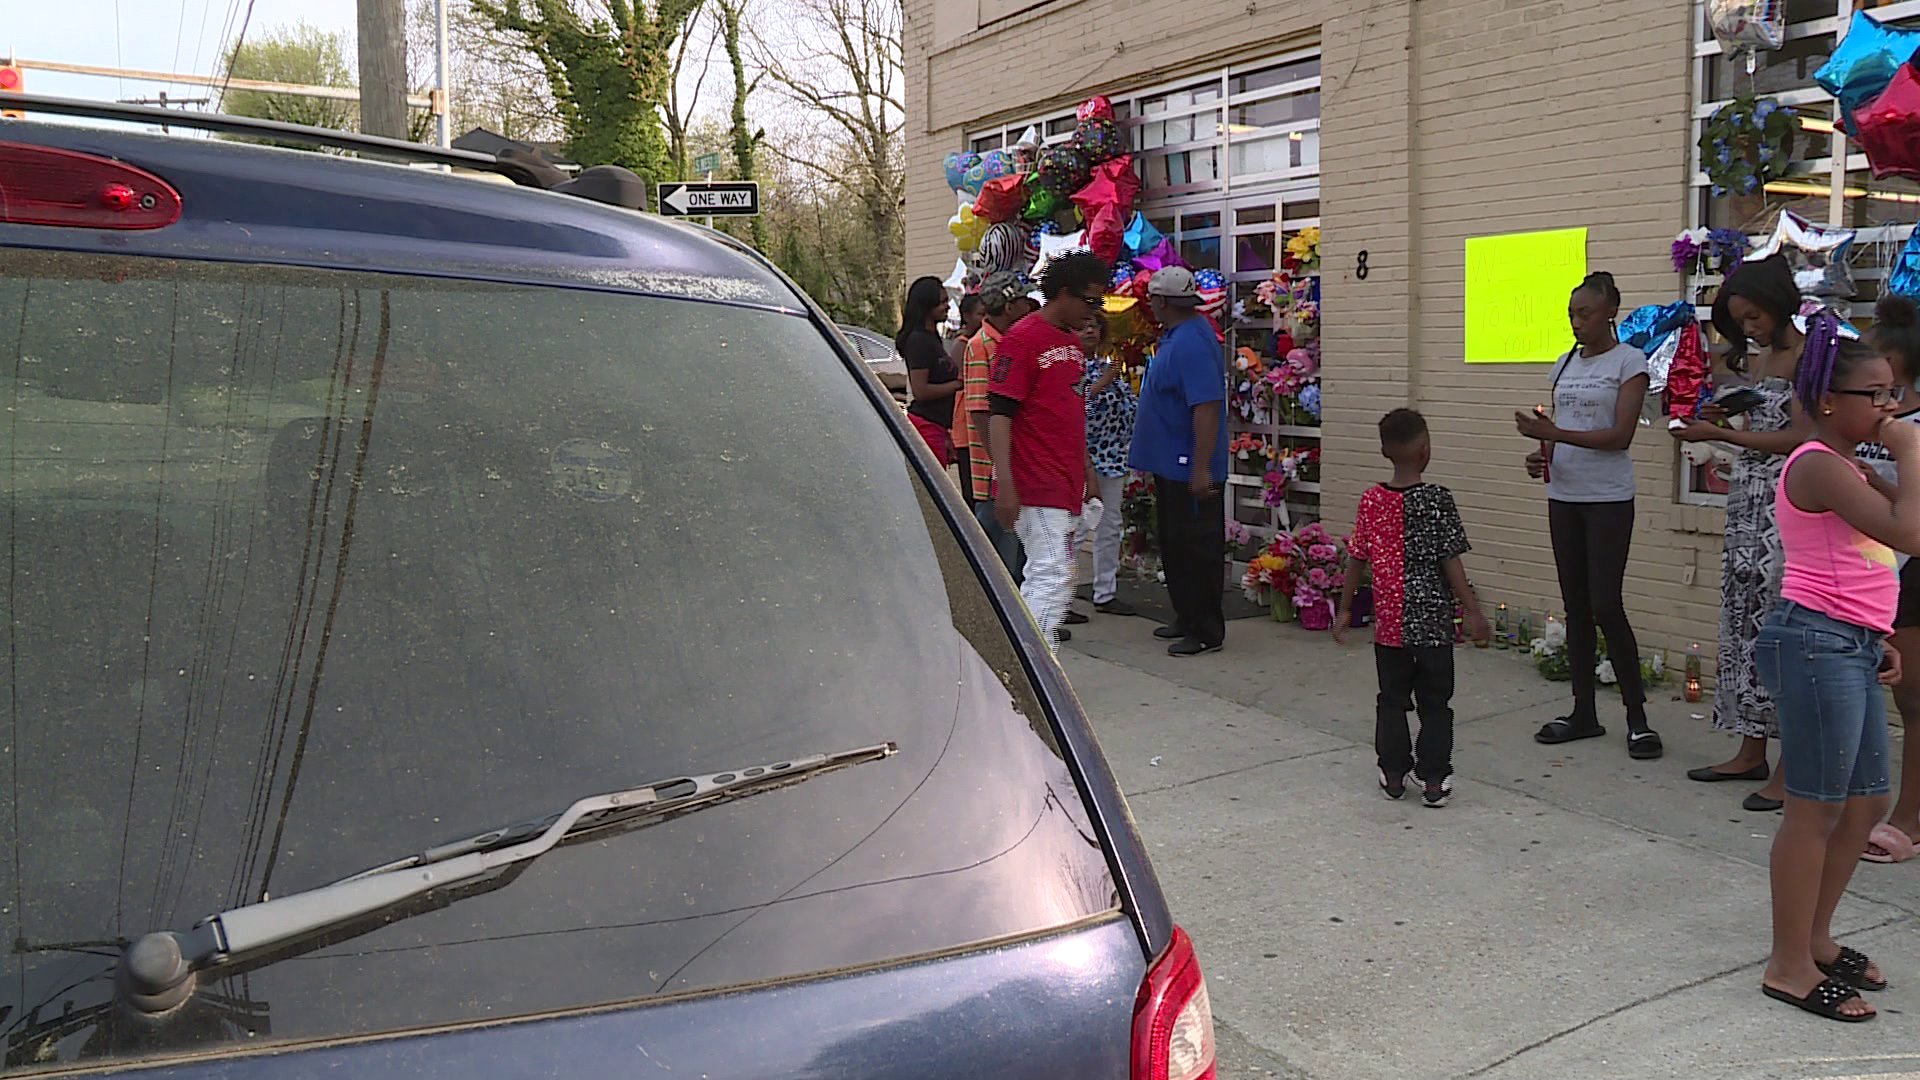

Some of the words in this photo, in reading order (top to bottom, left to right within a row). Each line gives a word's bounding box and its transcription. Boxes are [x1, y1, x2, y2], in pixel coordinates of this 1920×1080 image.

[689, 193, 716, 206] ONE
[720, 192, 747, 205] WAY
[1356, 250, 1369, 280] 8
